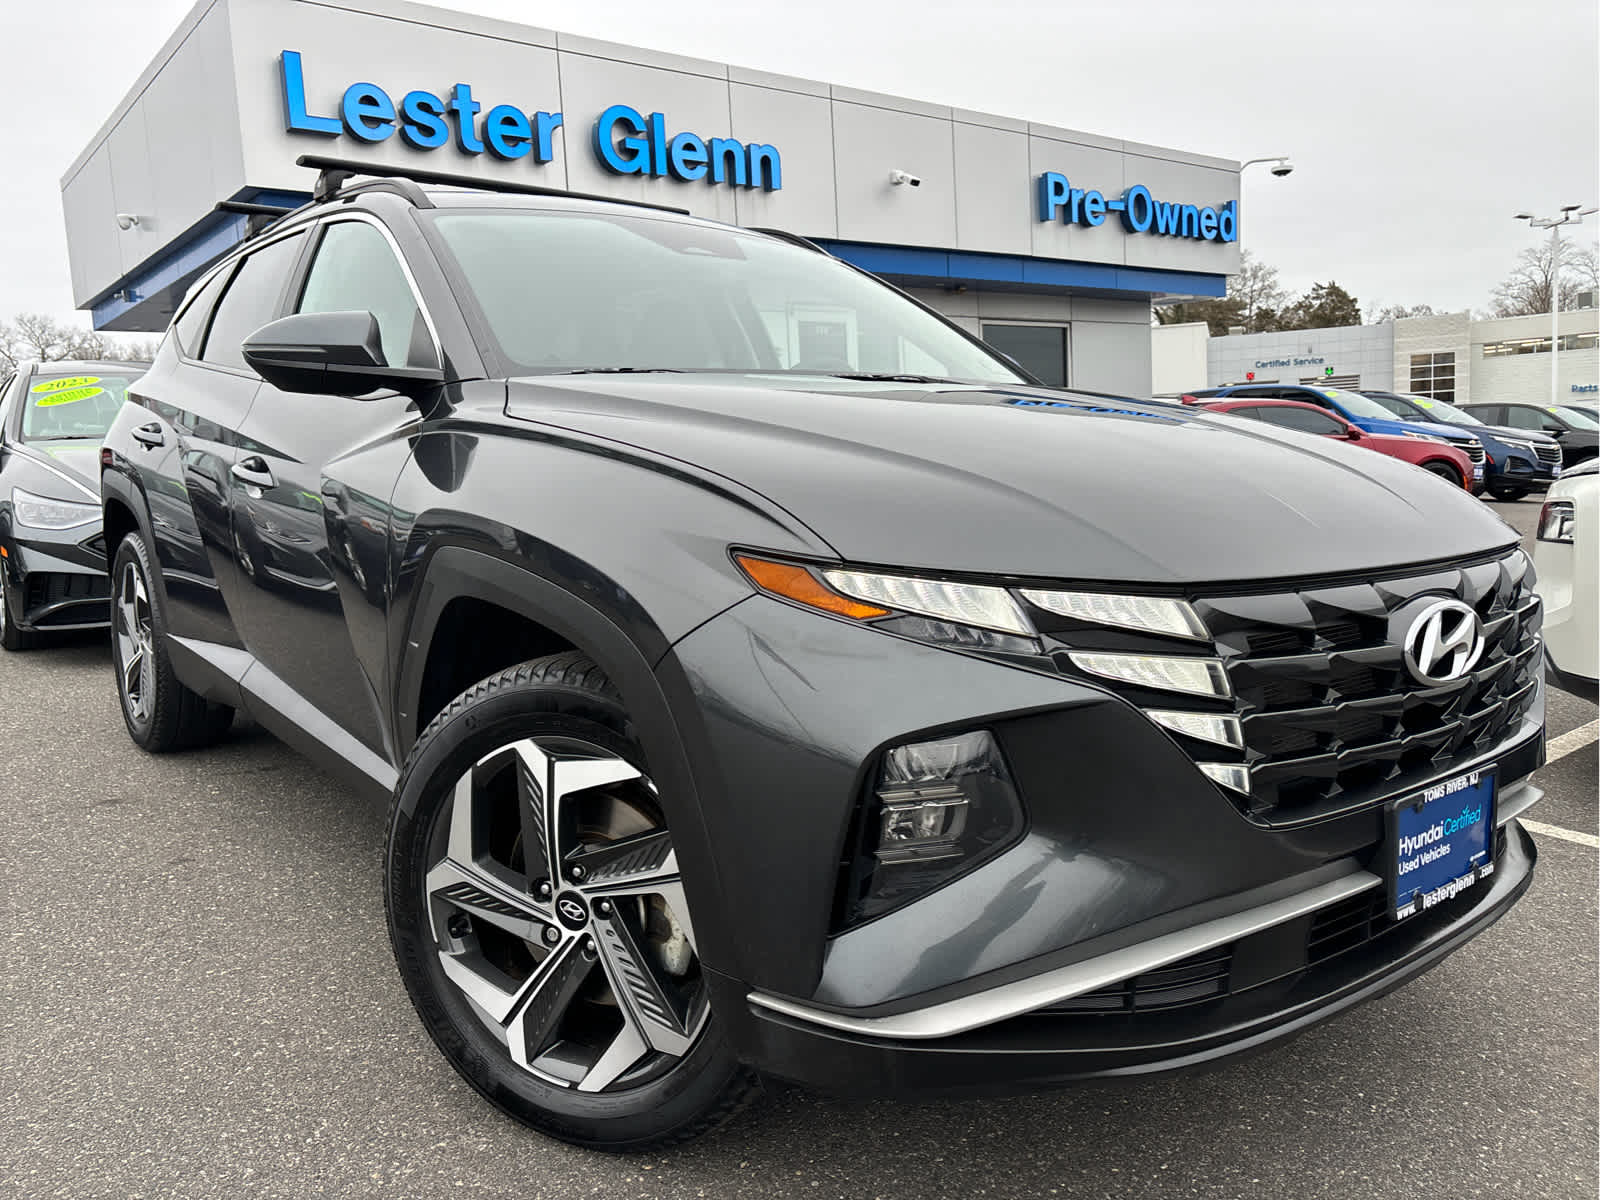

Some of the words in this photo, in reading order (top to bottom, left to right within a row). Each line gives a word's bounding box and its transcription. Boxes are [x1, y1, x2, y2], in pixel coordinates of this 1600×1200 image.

[280, 50, 564, 164] Lester
[593, 104, 783, 192] Glenn
[1039, 171, 1237, 242] Pre-Owned
[1255, 359, 1291, 368] Certified
[1293, 357, 1324, 366] Service
[1423, 785, 1446, 803] TOMS
[1469, 772, 1479, 786] NJ
[1398, 855, 1420, 876] Used
[1420, 843, 1451, 866] Vehicles
[1422, 874, 1475, 909] lesterglenn
